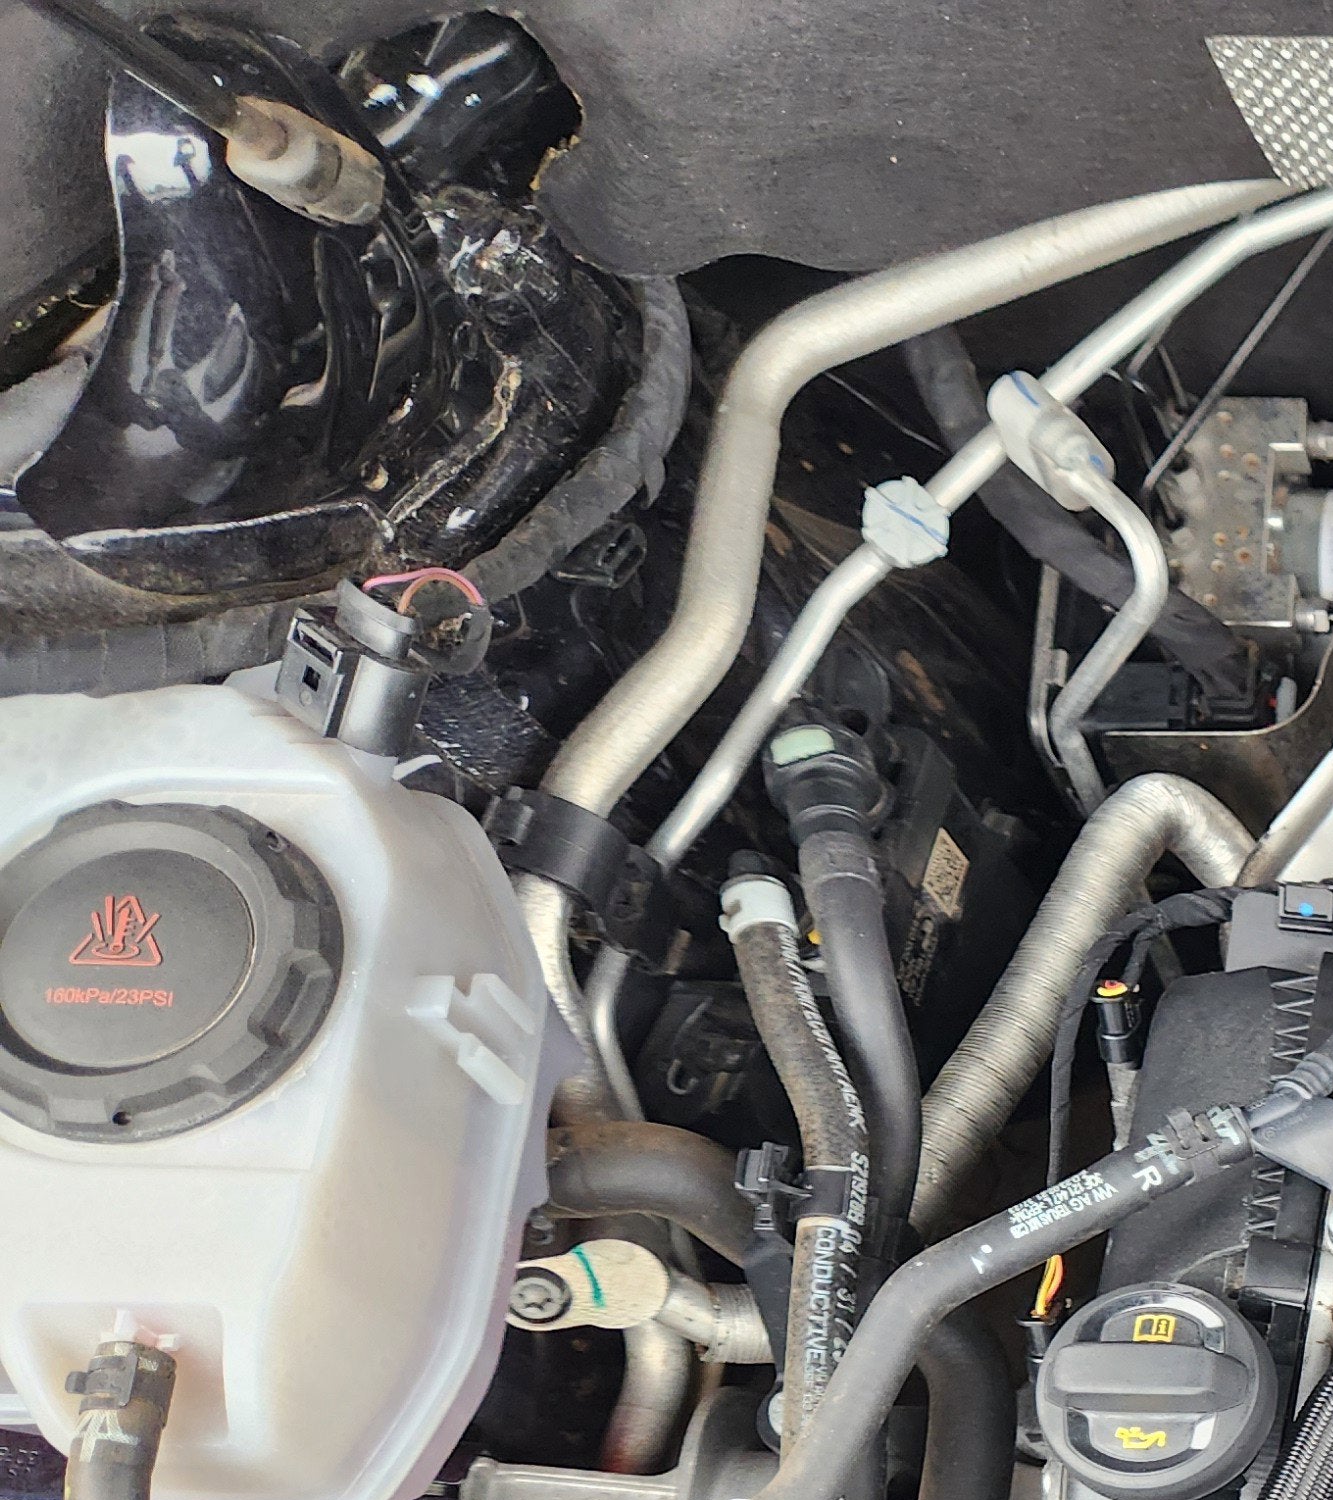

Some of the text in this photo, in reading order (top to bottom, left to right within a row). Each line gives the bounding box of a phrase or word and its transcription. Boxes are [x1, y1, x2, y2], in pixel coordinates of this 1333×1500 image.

[45, 987, 174, 1007] 160kPa/23PSI
[1091, 1183, 1118, 1202] VW
[1068, 1193, 1093, 1212] AG
[807, 1226, 838, 1366] CONDUCTIVE
